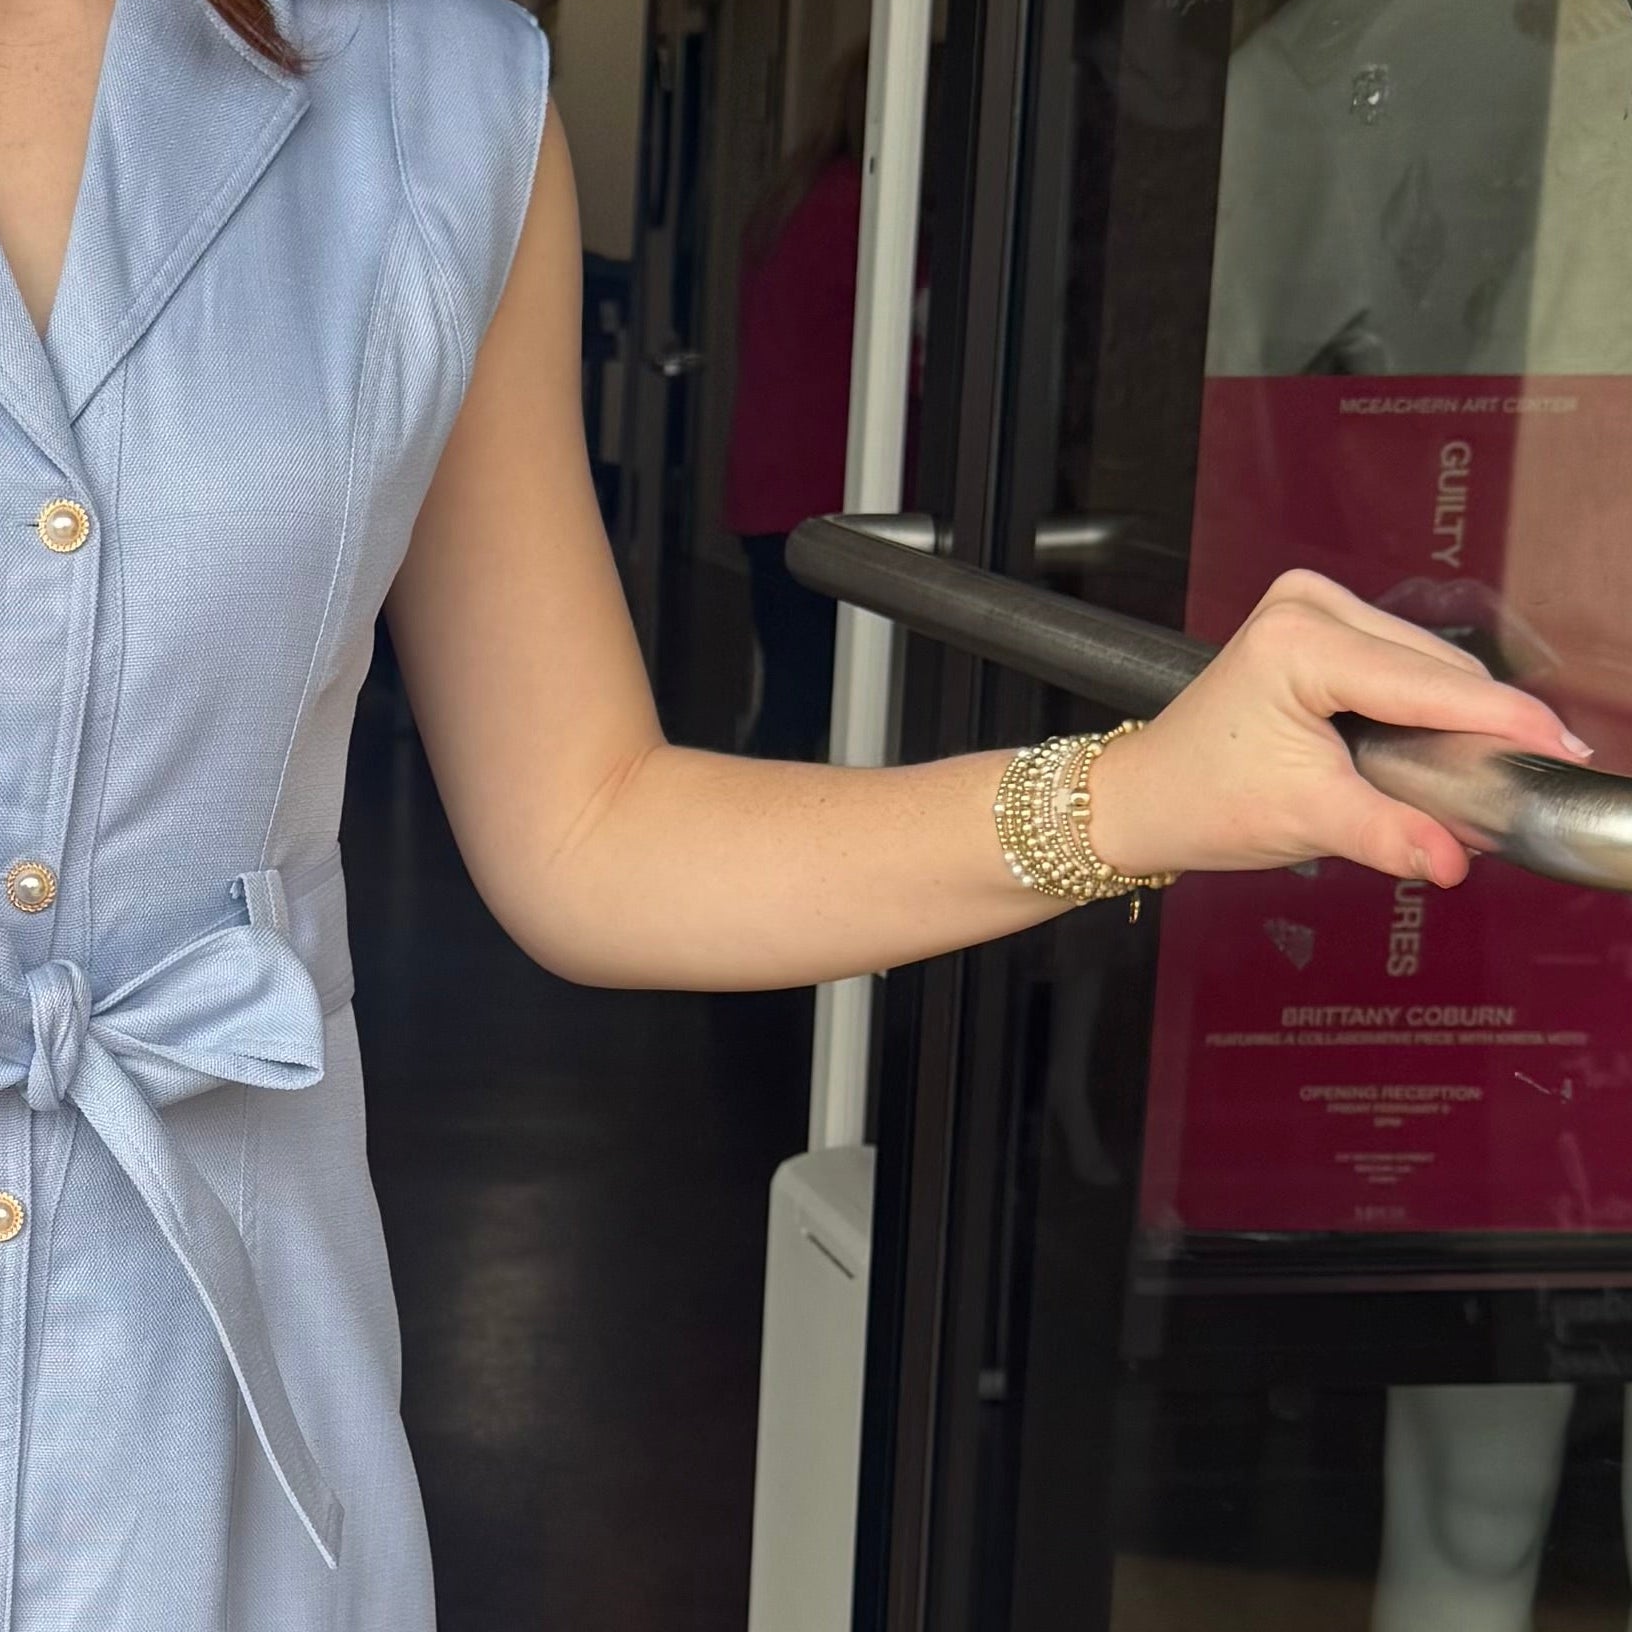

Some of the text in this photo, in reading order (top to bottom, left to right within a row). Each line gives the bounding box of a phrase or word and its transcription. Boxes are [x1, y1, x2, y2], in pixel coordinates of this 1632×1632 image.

[1459, 397, 1499, 414] ART
[1430, 440, 1471, 568] GUILTY
[1281, 1005, 1515, 1027] BRITTANY COBURN
[1299, 1085, 1483, 1101] OPENING RECEPTION
